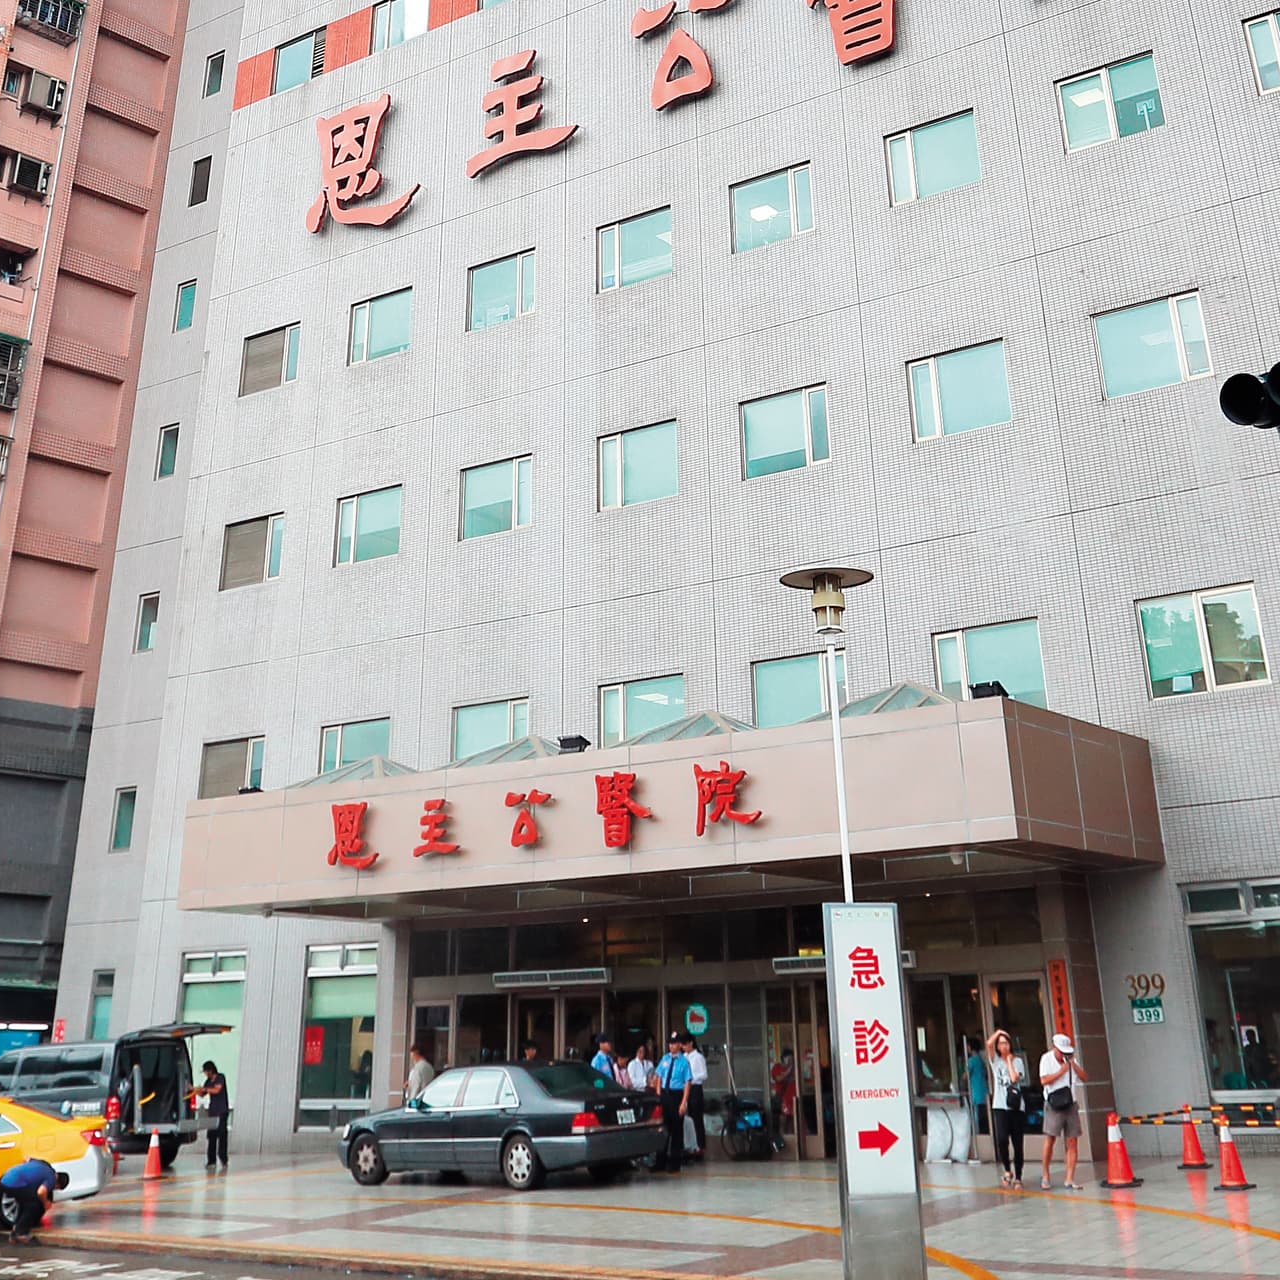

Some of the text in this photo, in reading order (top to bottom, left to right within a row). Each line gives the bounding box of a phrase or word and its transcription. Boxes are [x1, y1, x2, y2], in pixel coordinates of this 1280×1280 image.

[327, 760, 762, 870] 恩主公醫院
[1126, 973, 1165, 999] 399
[848, 946, 889, 1066] 急診
[1137, 1009, 1160, 1022] 399
[849, 1088, 900, 1100] EMERGENCY
